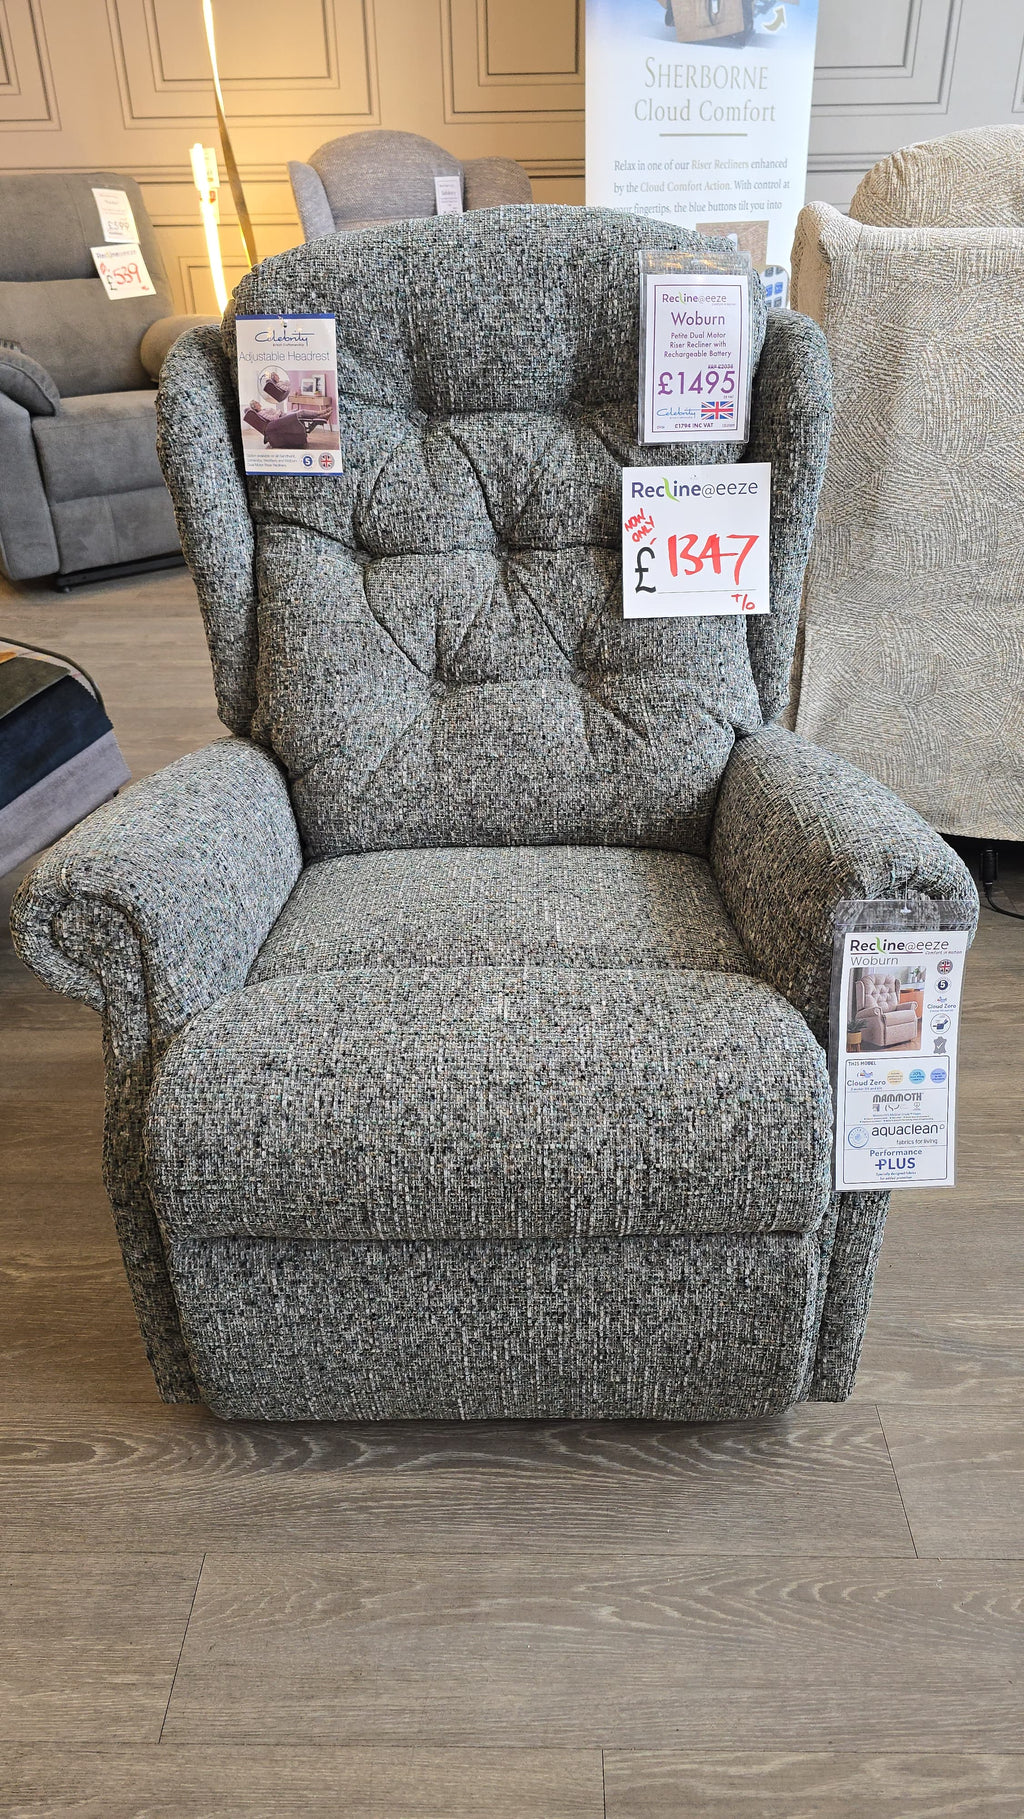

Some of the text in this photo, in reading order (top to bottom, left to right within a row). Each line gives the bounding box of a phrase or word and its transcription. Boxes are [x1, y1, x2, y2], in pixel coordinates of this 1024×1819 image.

[644, 56, 768, 90] SHERBORNE
[634, 98, 776, 122] Cloud Comfort
[614, 158, 788, 171] Relax in one of our Riser Recliners enhanced
[614, 179, 790, 196] by the Cloud Comfort Action. With control at
[634, 203, 670, 216] fingertips,
[674, 202, 687, 213] the
[688, 201, 704, 212] blue
[708, 201, 737, 212] buttons
[738, 200, 749, 211] tilt
[750, 202, 765, 214] you
[767, 200, 783, 210] into
[671, 311, 725, 326] Woburn
[255, 329, 315, 347] Celebrity
[714, 340, 726, 348] with
[239, 351, 330, 364] Adjustable Headrest
[664, 350, 732, 360] Rechargeable Battery
[658, 370, 736, 395] £1495
[656, 407, 700, 419] Celebrity
[624, 508, 646, 532] NOW
[632, 516, 655, 542] ONLY
[850, 956, 898, 966] Woburn
[872, 1092, 922, 1103] MAMMOTH
[872, 1124, 938, 1138] aquaclean
[870, 1149, 922, 1157] Performance
